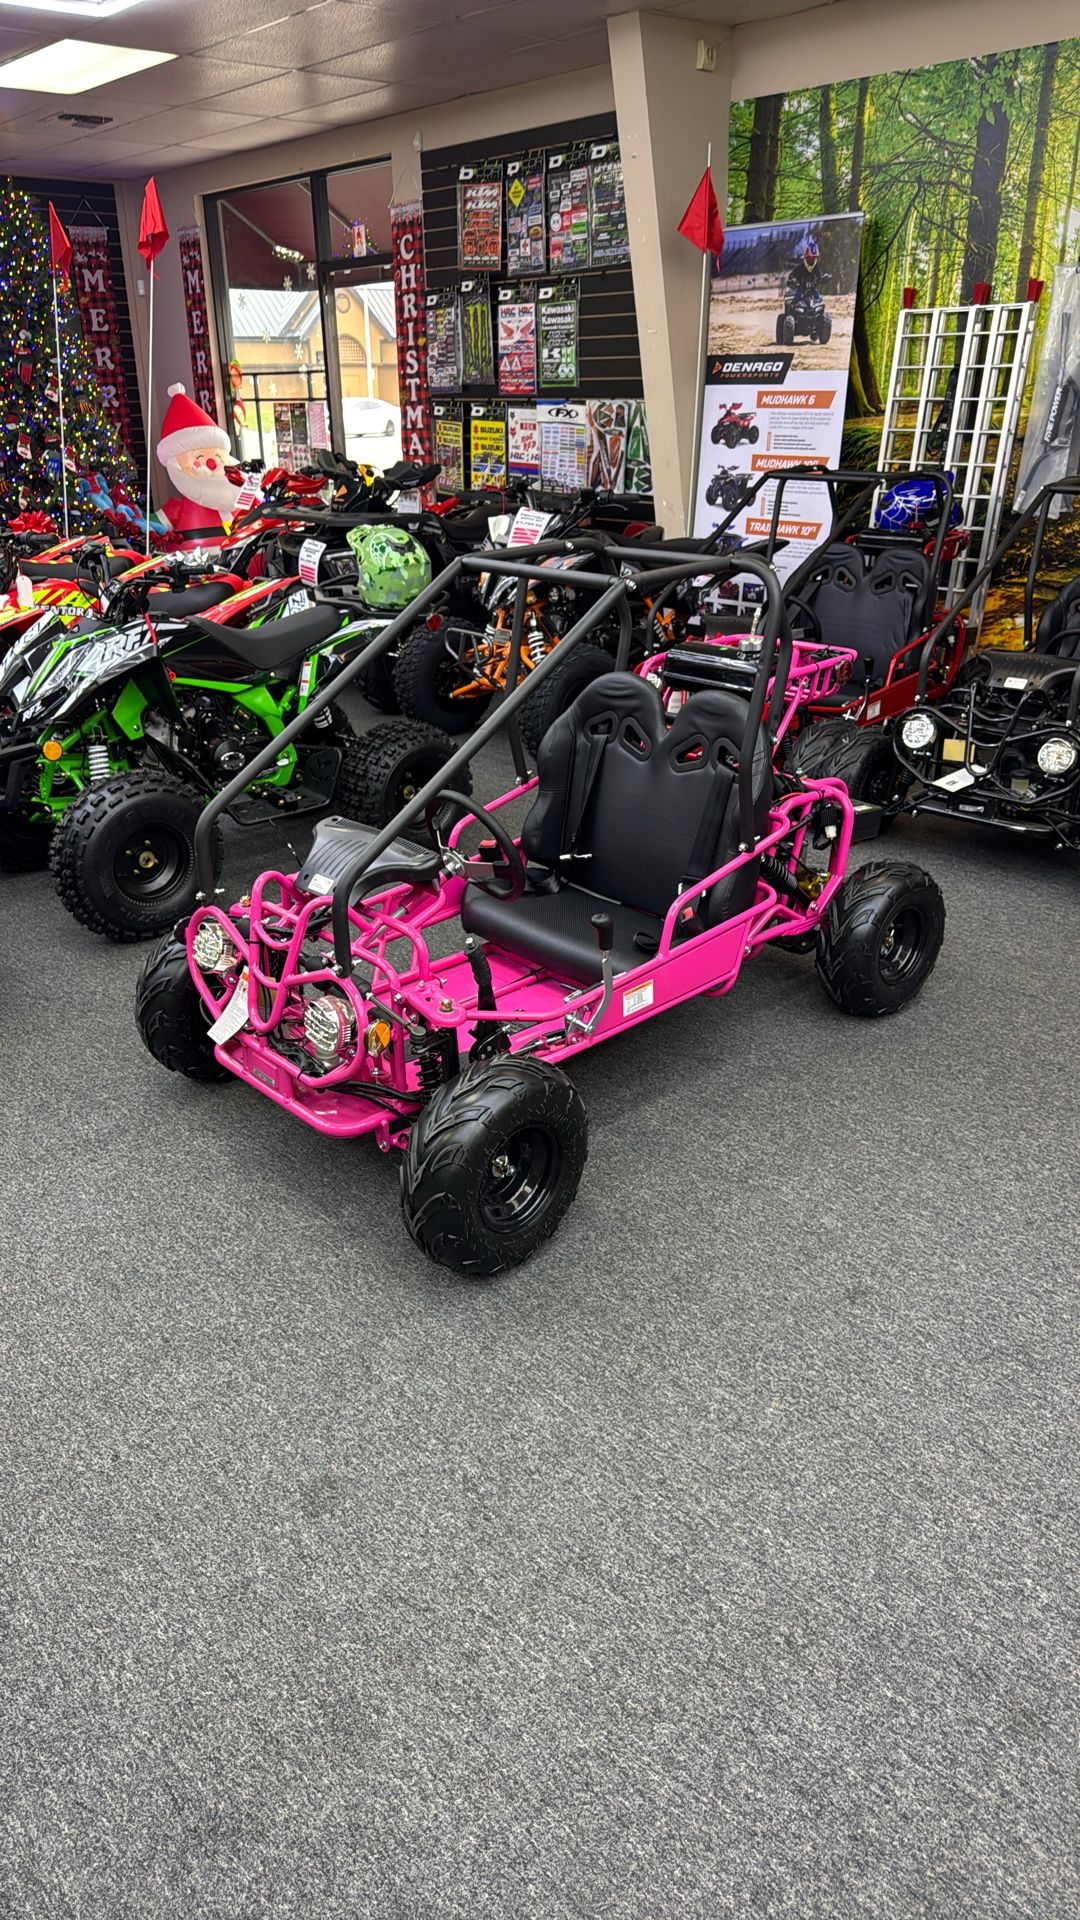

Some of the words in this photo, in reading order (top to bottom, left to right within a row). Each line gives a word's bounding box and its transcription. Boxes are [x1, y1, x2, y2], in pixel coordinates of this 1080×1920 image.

[466, 187, 498, 198] KTM
[466, 199, 498, 209] KTM
[541, 304, 574, 315] Kawasaki
[541, 313, 574, 325] Kawasaki
[722, 361, 784, 373] DENAGO
[761, 395, 807, 405] MUDHAWK
[808, 395, 815, 405] 6
[480, 426, 503, 434] SUZUKI
[510, 451, 525, 460] HRC
[22, 701, 45, 722] RFZ
